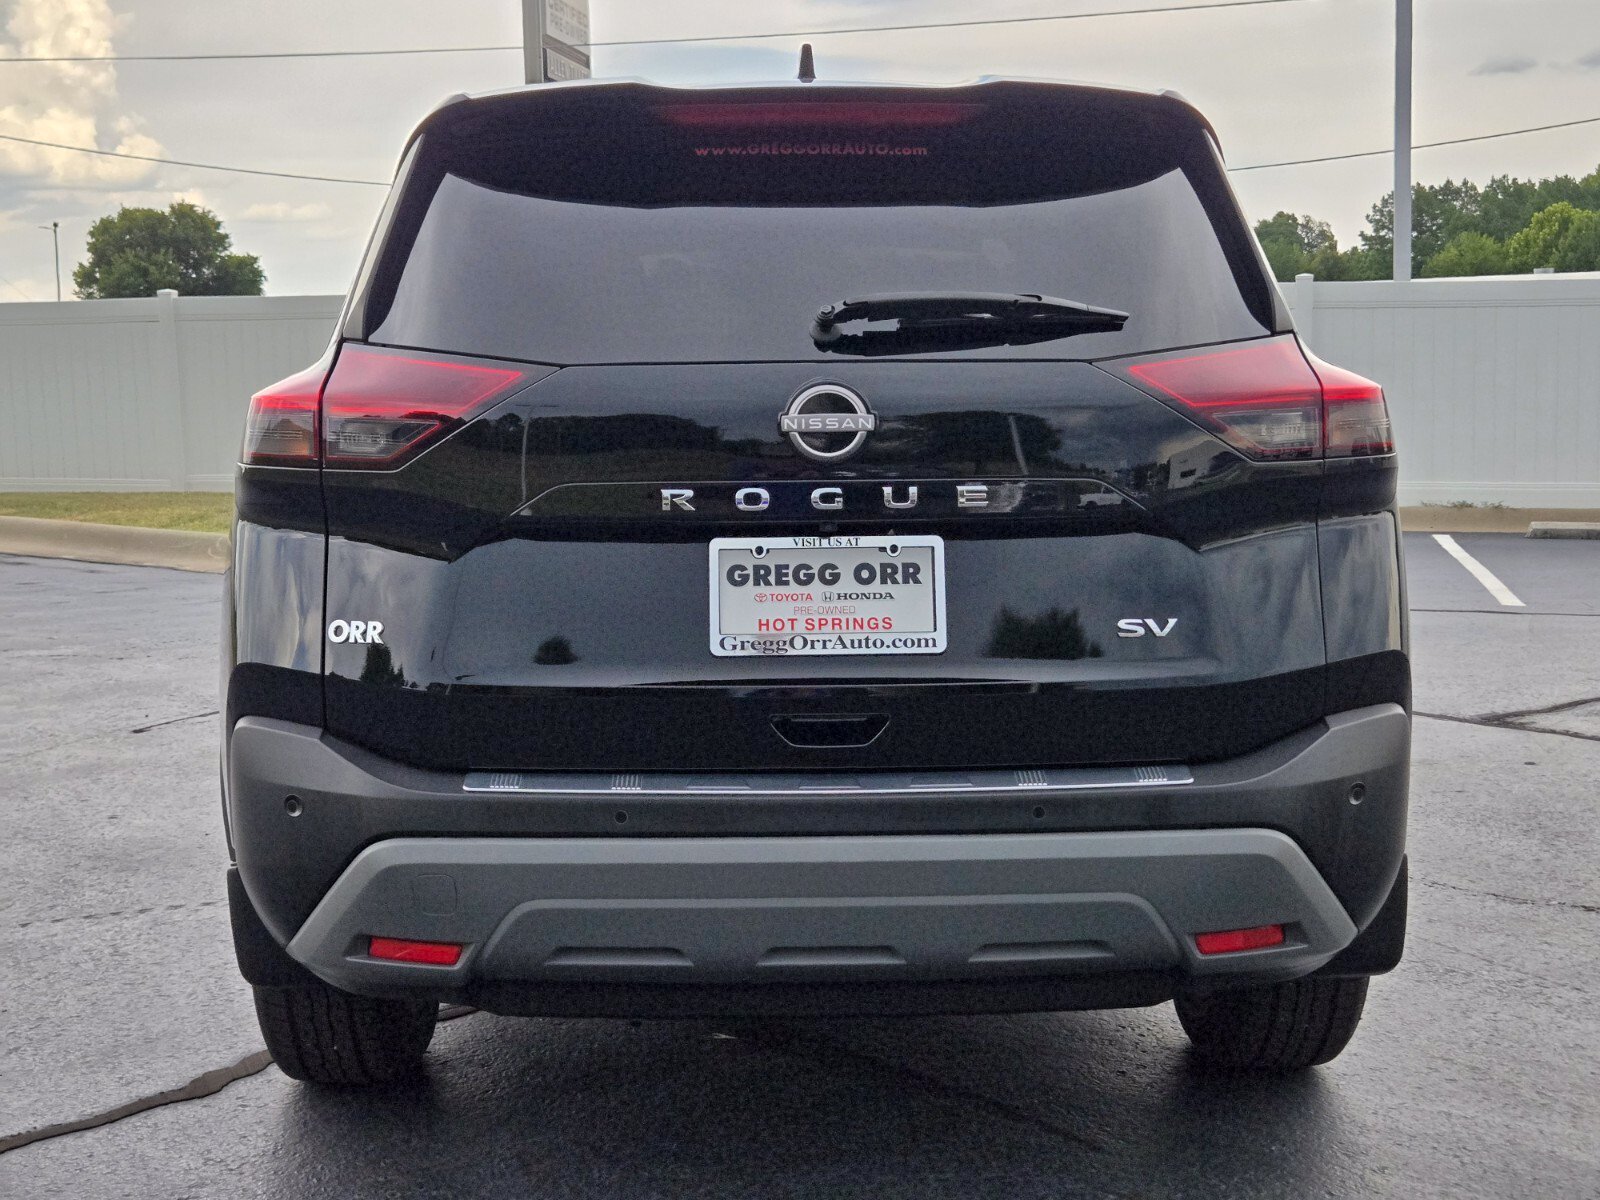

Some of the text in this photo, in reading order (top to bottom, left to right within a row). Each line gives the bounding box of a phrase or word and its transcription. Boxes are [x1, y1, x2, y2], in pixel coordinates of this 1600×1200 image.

[784, 417, 873, 430] NISSAN
[661, 485, 989, 511] ROGUE
[793, 537, 861, 547] VISIT US AT
[726, 562, 923, 587] GREGG ORR
[769, 593, 813, 602] TOYOTA
[837, 592, 895, 600] HONDA
[793, 605, 856, 615] PRE-OWNED
[327, 619, 384, 644] ORR
[758, 616, 893, 632] HOT SPRINGS
[1117, 618, 1178, 637] SV
[719, 634, 937, 654] GreggOrrAuto.com
